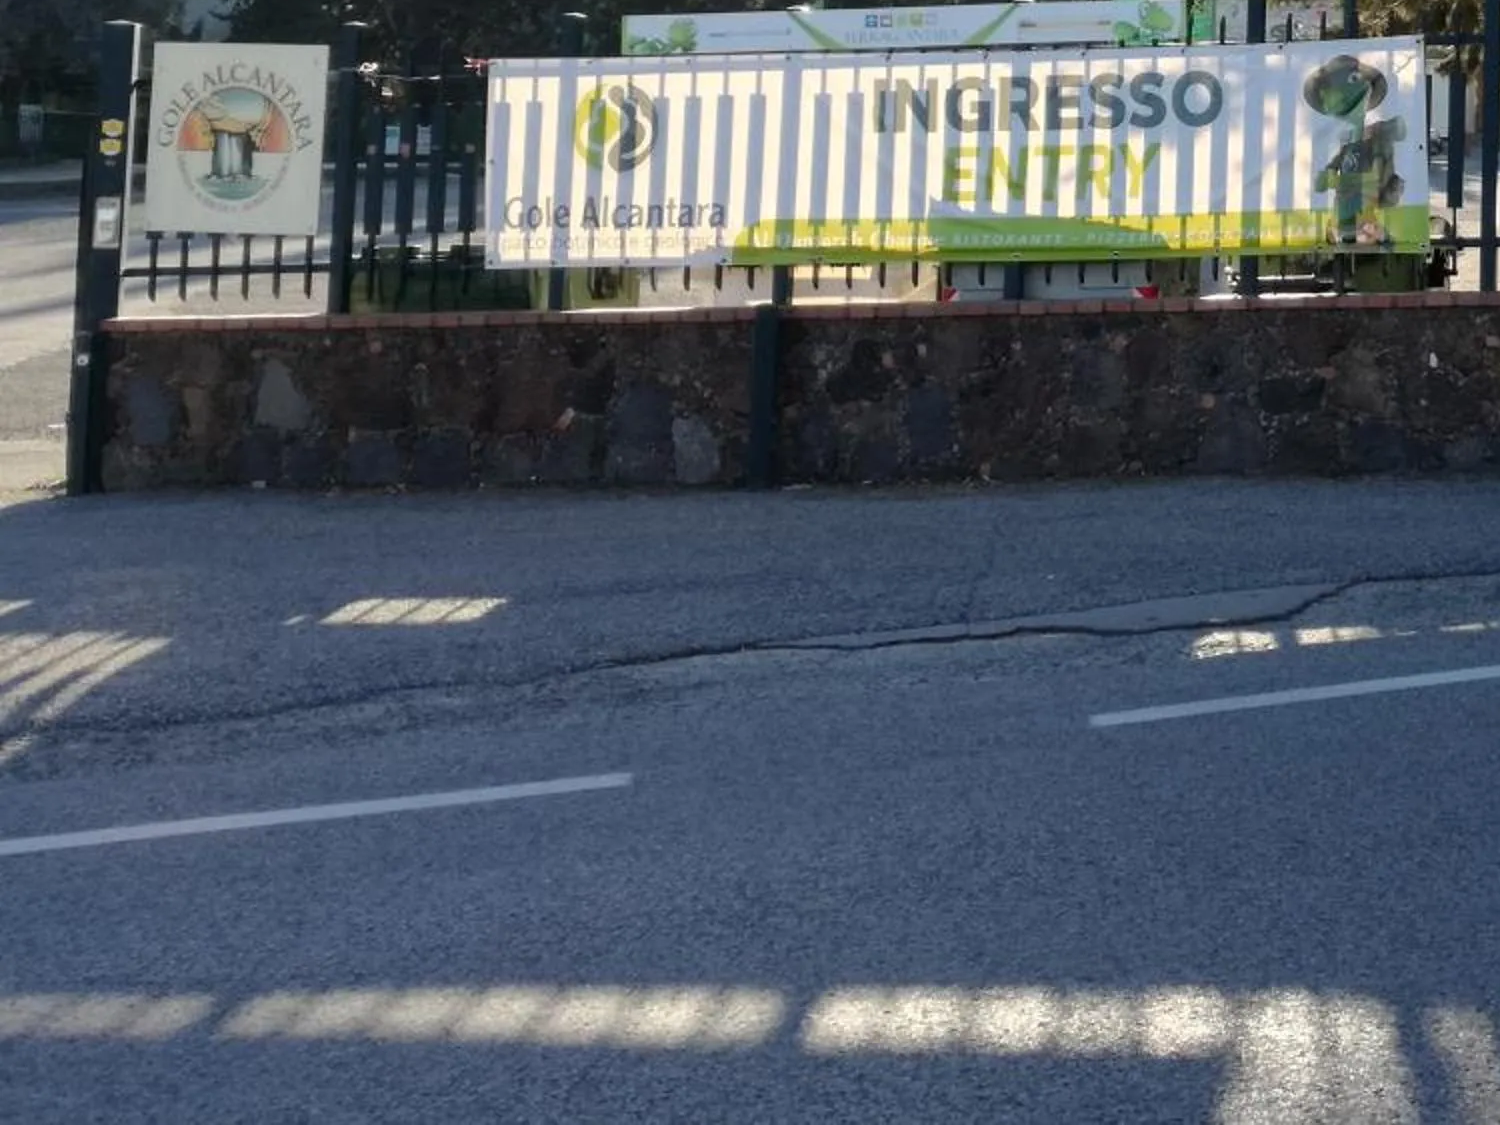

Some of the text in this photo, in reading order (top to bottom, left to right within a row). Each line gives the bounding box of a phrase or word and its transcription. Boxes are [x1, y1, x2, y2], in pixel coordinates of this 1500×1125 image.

[157, 62, 314, 152] GOLE ALCANTARA
[874, 69, 1223, 134] INGRESSO
[942, 141, 1162, 203] ENTRY
[503, 195, 727, 230] Gole Alcantara
[952, 231, 1064, 246] RISTORANTE
